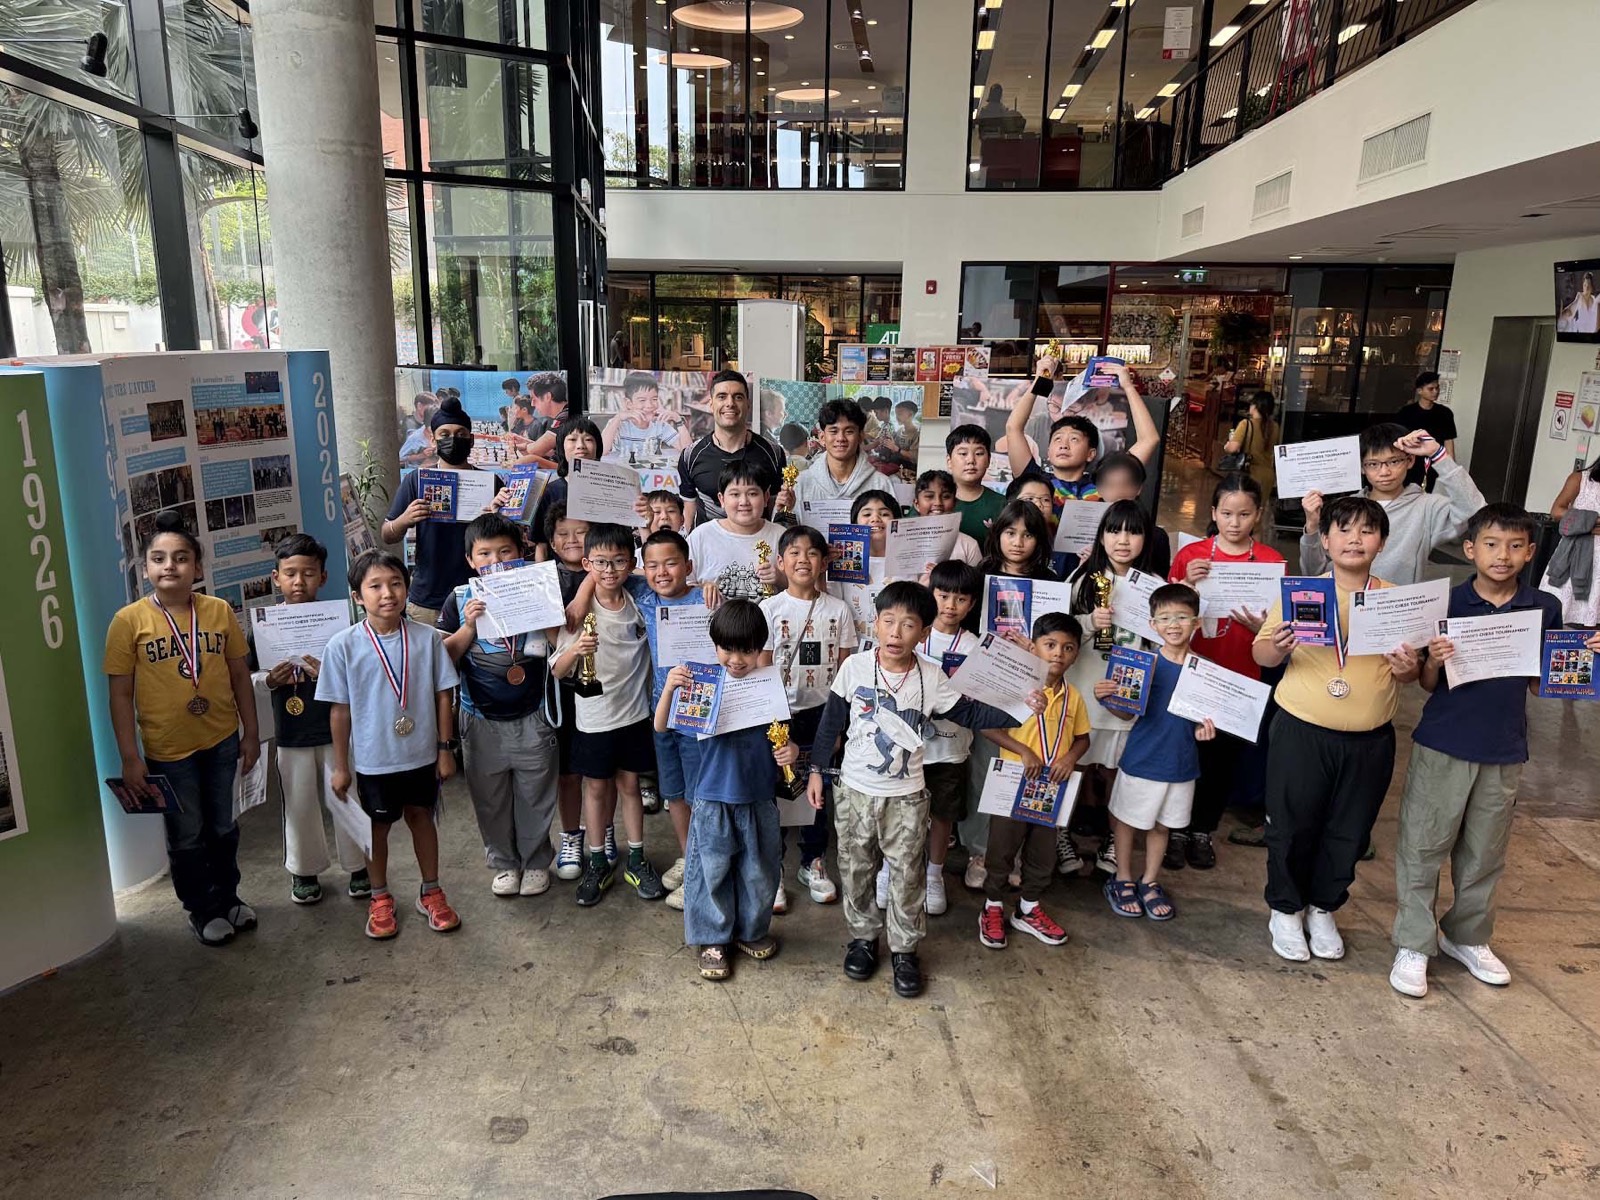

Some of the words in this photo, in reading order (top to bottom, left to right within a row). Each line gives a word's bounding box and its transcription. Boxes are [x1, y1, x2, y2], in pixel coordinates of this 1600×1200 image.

[879, 330, 901, 344] AT
[128, 380, 157, 395] L'AVENIR
[313, 371, 336, 522] 2026
[654, 474, 679, 488] PA
[16, 408, 63, 650] 1926
[1411, 597, 1440, 606] TOURNAMENT
